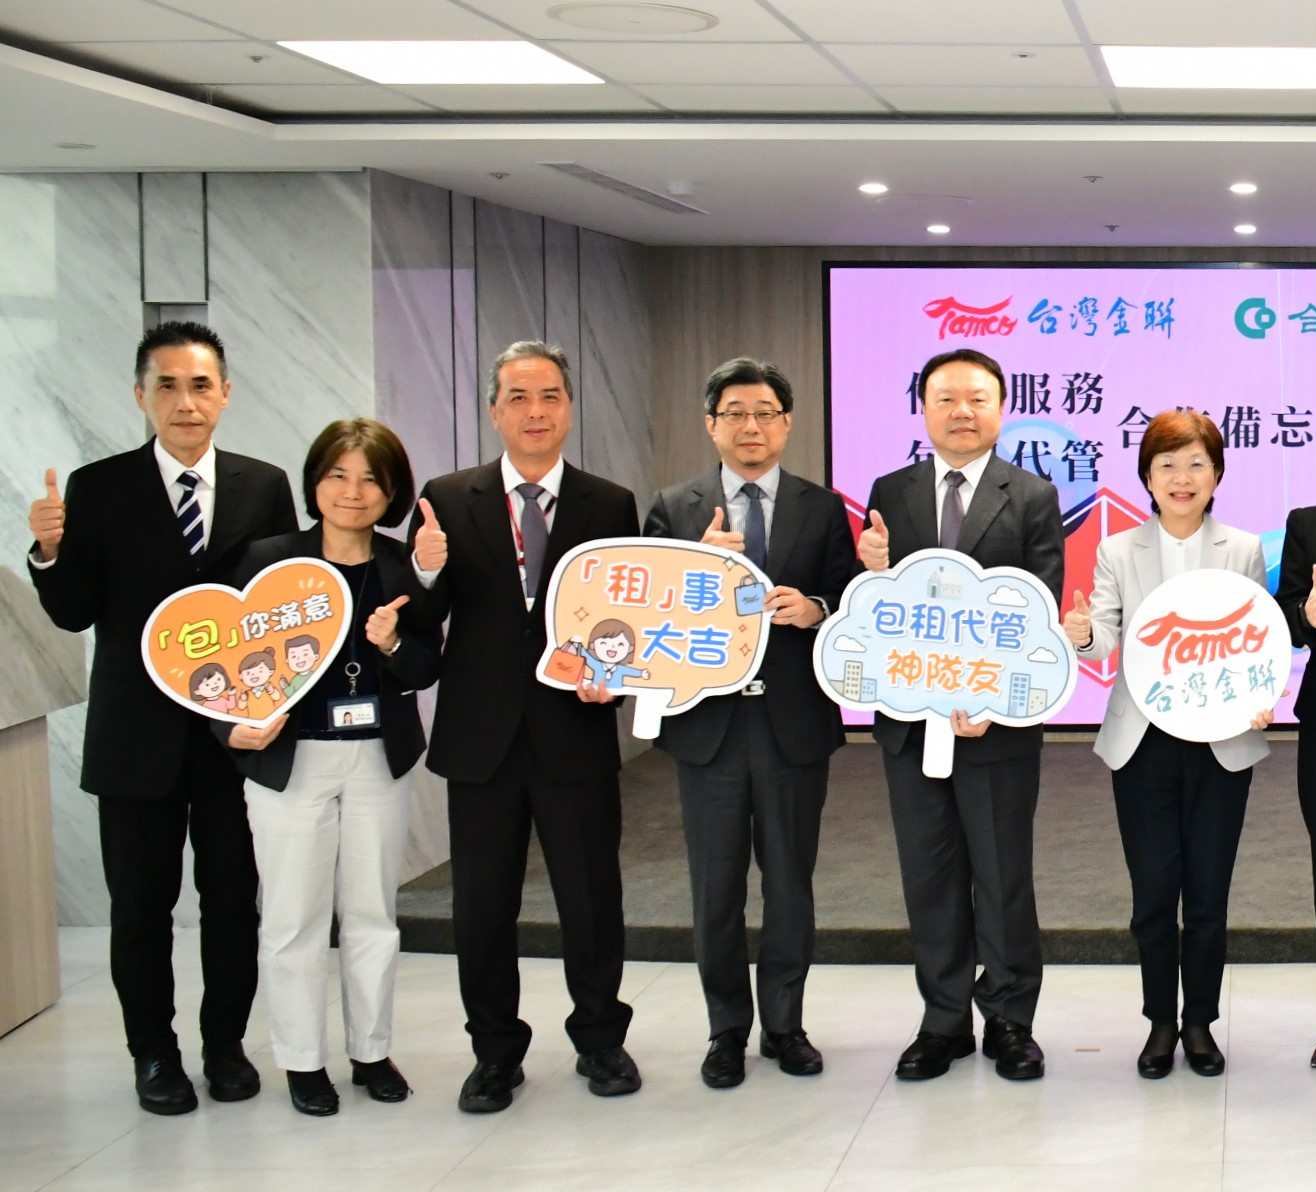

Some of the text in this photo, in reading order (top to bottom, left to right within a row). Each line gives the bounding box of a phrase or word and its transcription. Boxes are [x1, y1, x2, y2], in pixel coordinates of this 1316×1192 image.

[1027, 297, 1176, 339] 台灣金聯
[906, 372, 1104, 414] 服務
[907, 440, 1104, 482] 代管
[582, 557, 723, 612] 「租」事
[158, 593, 334, 660] 「包」你滿意
[642, 622, 730, 665] 大吉
[871, 600, 1027, 650] 包租代管
[886, 649, 1003, 694] 神隊友
[1144, 659, 1276, 713] 台灣金聯
